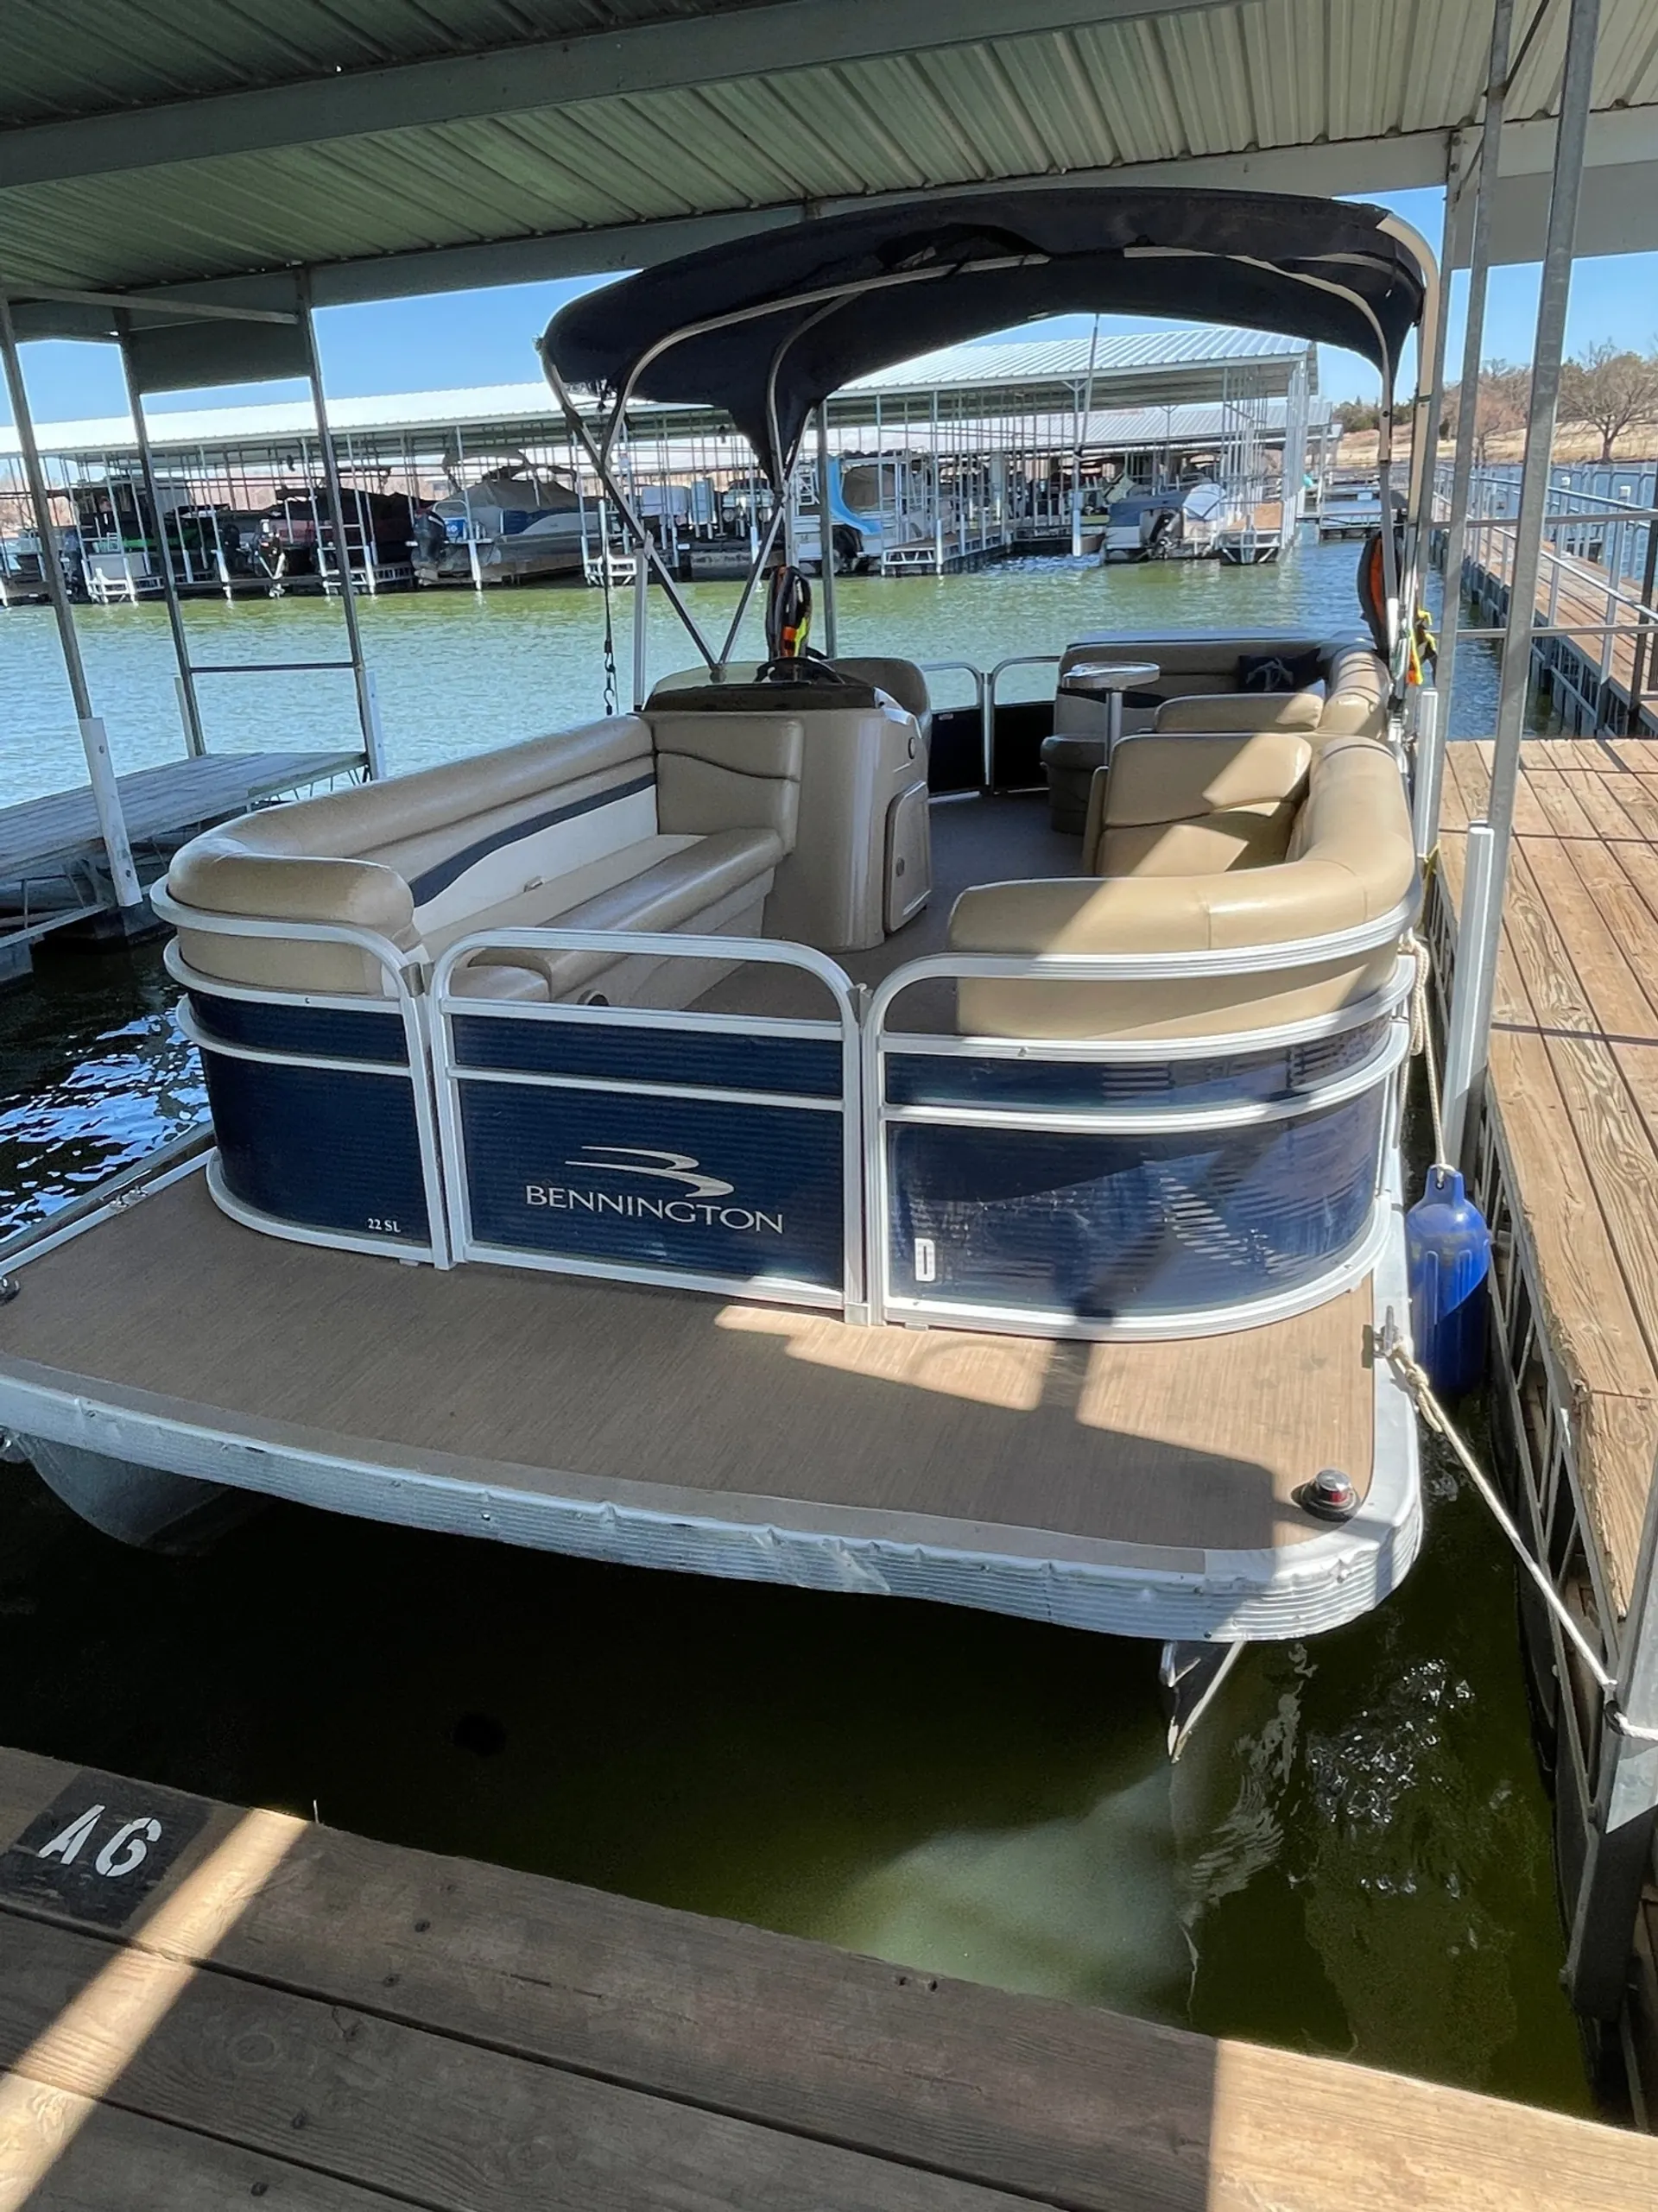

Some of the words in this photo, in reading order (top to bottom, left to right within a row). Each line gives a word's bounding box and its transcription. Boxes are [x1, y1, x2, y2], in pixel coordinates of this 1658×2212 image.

[368, 1217, 383, 1231] 22
[384, 1220, 402, 1234] SL
[526, 1185, 783, 1234] BENNINGTON
